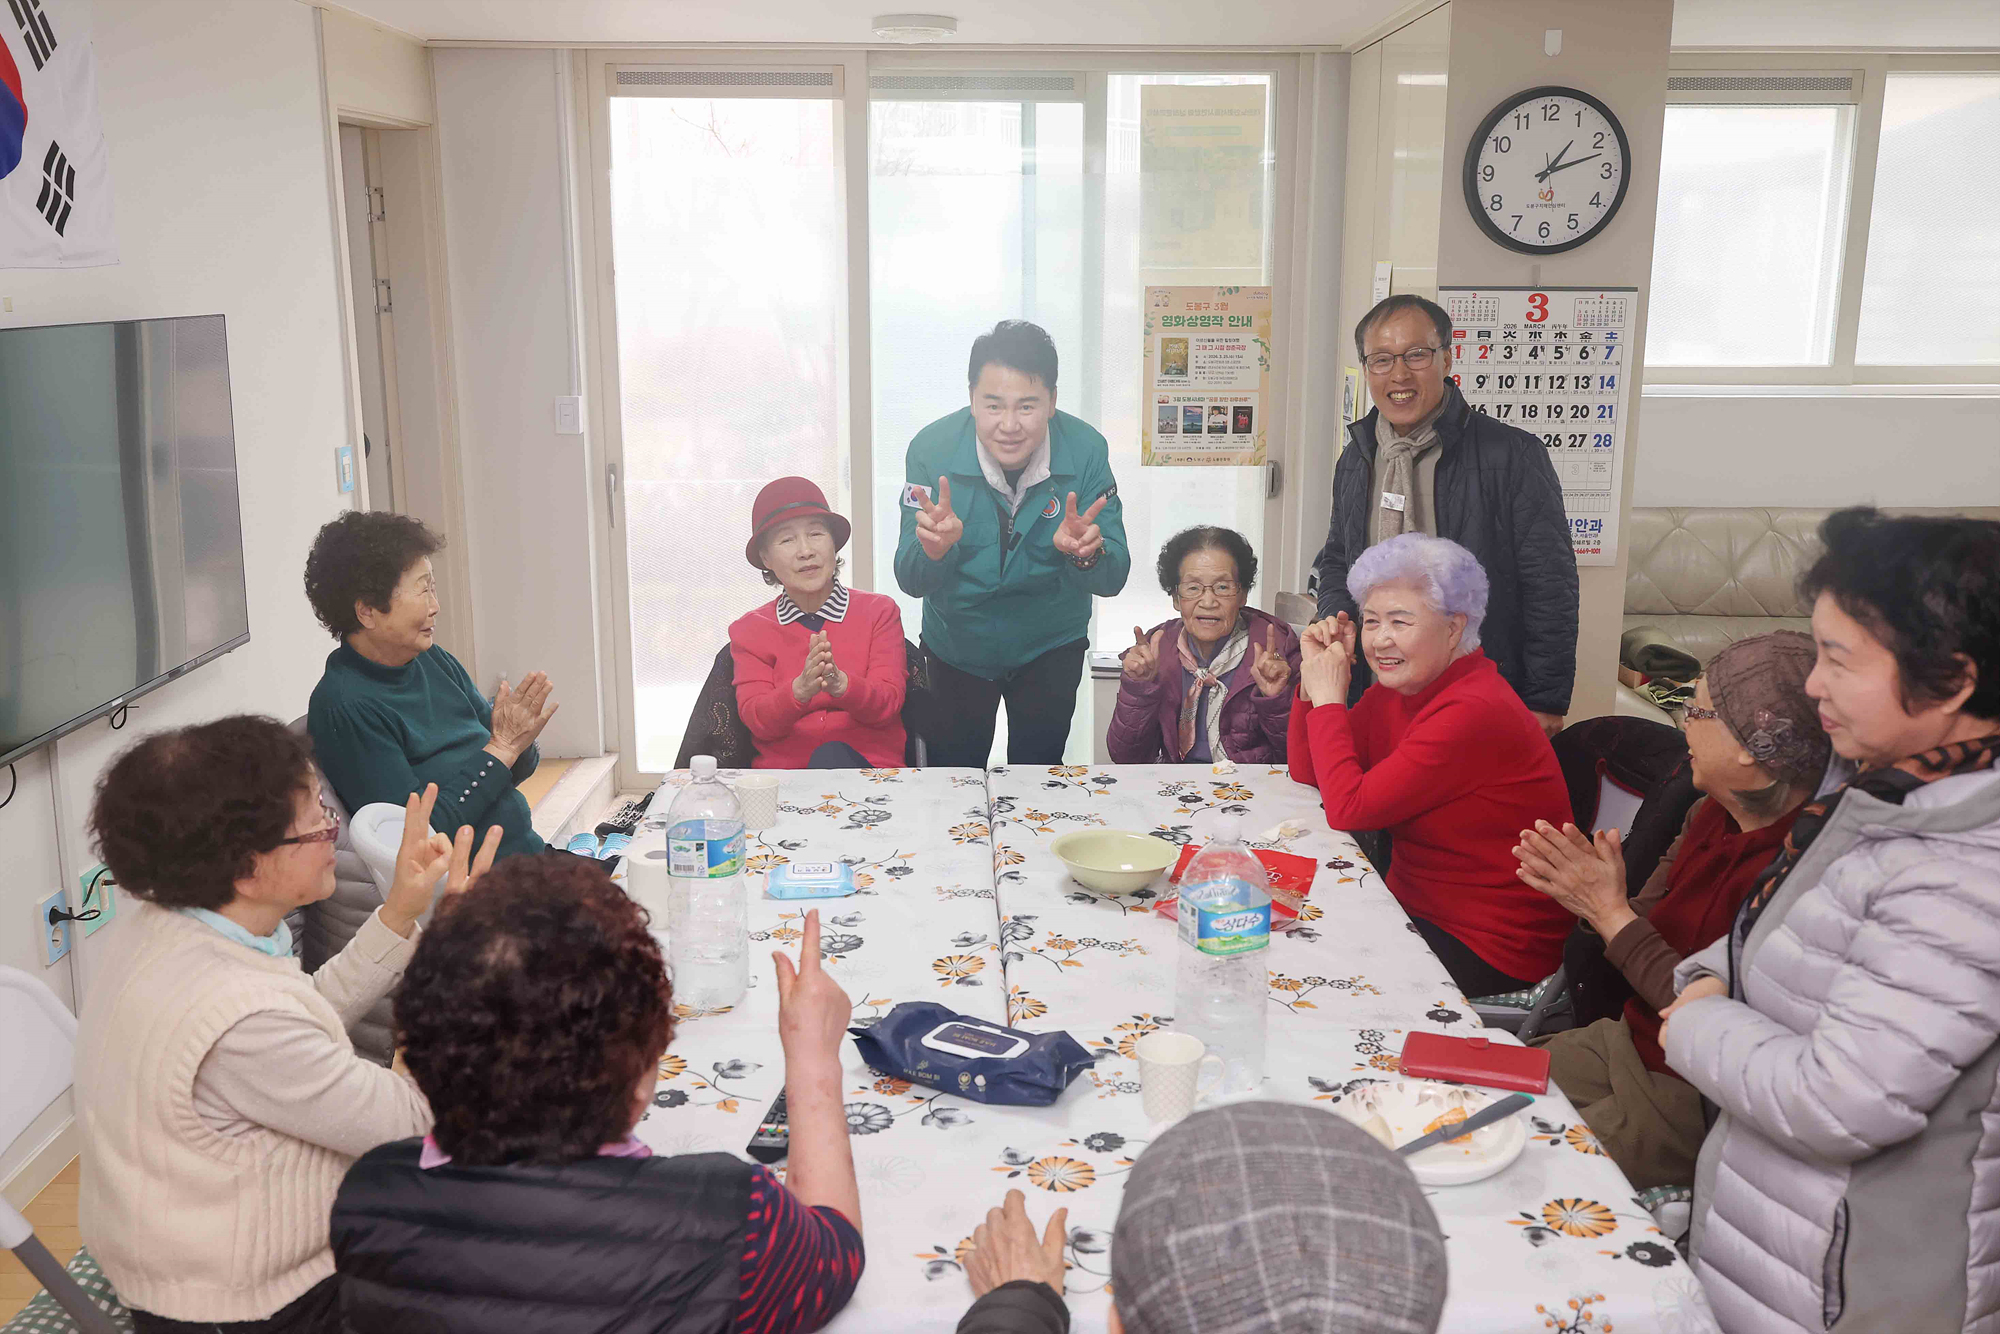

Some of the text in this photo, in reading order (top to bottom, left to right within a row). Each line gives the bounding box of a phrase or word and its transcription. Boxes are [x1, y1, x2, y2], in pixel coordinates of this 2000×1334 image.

[1541, 104, 1560, 122] 12
[1574, 110, 1581, 128] 1
[1514, 113, 1530, 130] 11
[1492, 136, 1511, 153] 10
[1592, 132, 1604, 149] 2
[1482, 165, 1494, 182] 9
[1600, 162, 1612, 179] 3
[1490, 194, 1502, 211] 8
[1589, 192, 1601, 208] 4
[1511, 215, 1523, 231] 7
[1538, 222, 1550, 238] 6
[1567, 214, 1578, 230] 5
[1186, 302, 1229, 311] 도봉구 3월
[1526, 293, 1549, 322] 3
[1162, 315, 1252, 327] 영화상영작 안내
[1452, 330, 1466, 338] 日
[1477, 330, 1491, 338] 月
[1554, 331, 1567, 339] 木
[1580, 331, 1593, 339] 金
[1605, 331, 1618, 339] 土
[1456, 345, 1615, 360] 1 2 3 4 5 6 7
[1476, 375, 1486, 388] 9
[1498, 375, 1514, 389] 10
[1524, 375, 1540, 389] 11
[1549, 375, 1565, 389] 12
[1574, 376, 1590, 389] 13
[1599, 376, 1615, 389] 14
[1496, 404, 1513, 418] 17
[1521, 405, 1538, 418] 18
[1547, 405, 1564, 418] 19
[1570, 405, 1590, 418] 20
[1597, 405, 1613, 418] 21
[1544, 434, 1612, 447] 26 27 28
[1571, 464, 1579, 475] 3
[1222, 913, 1260, 931] 삼다수
[918, 1071, 932, 1079] BOM
